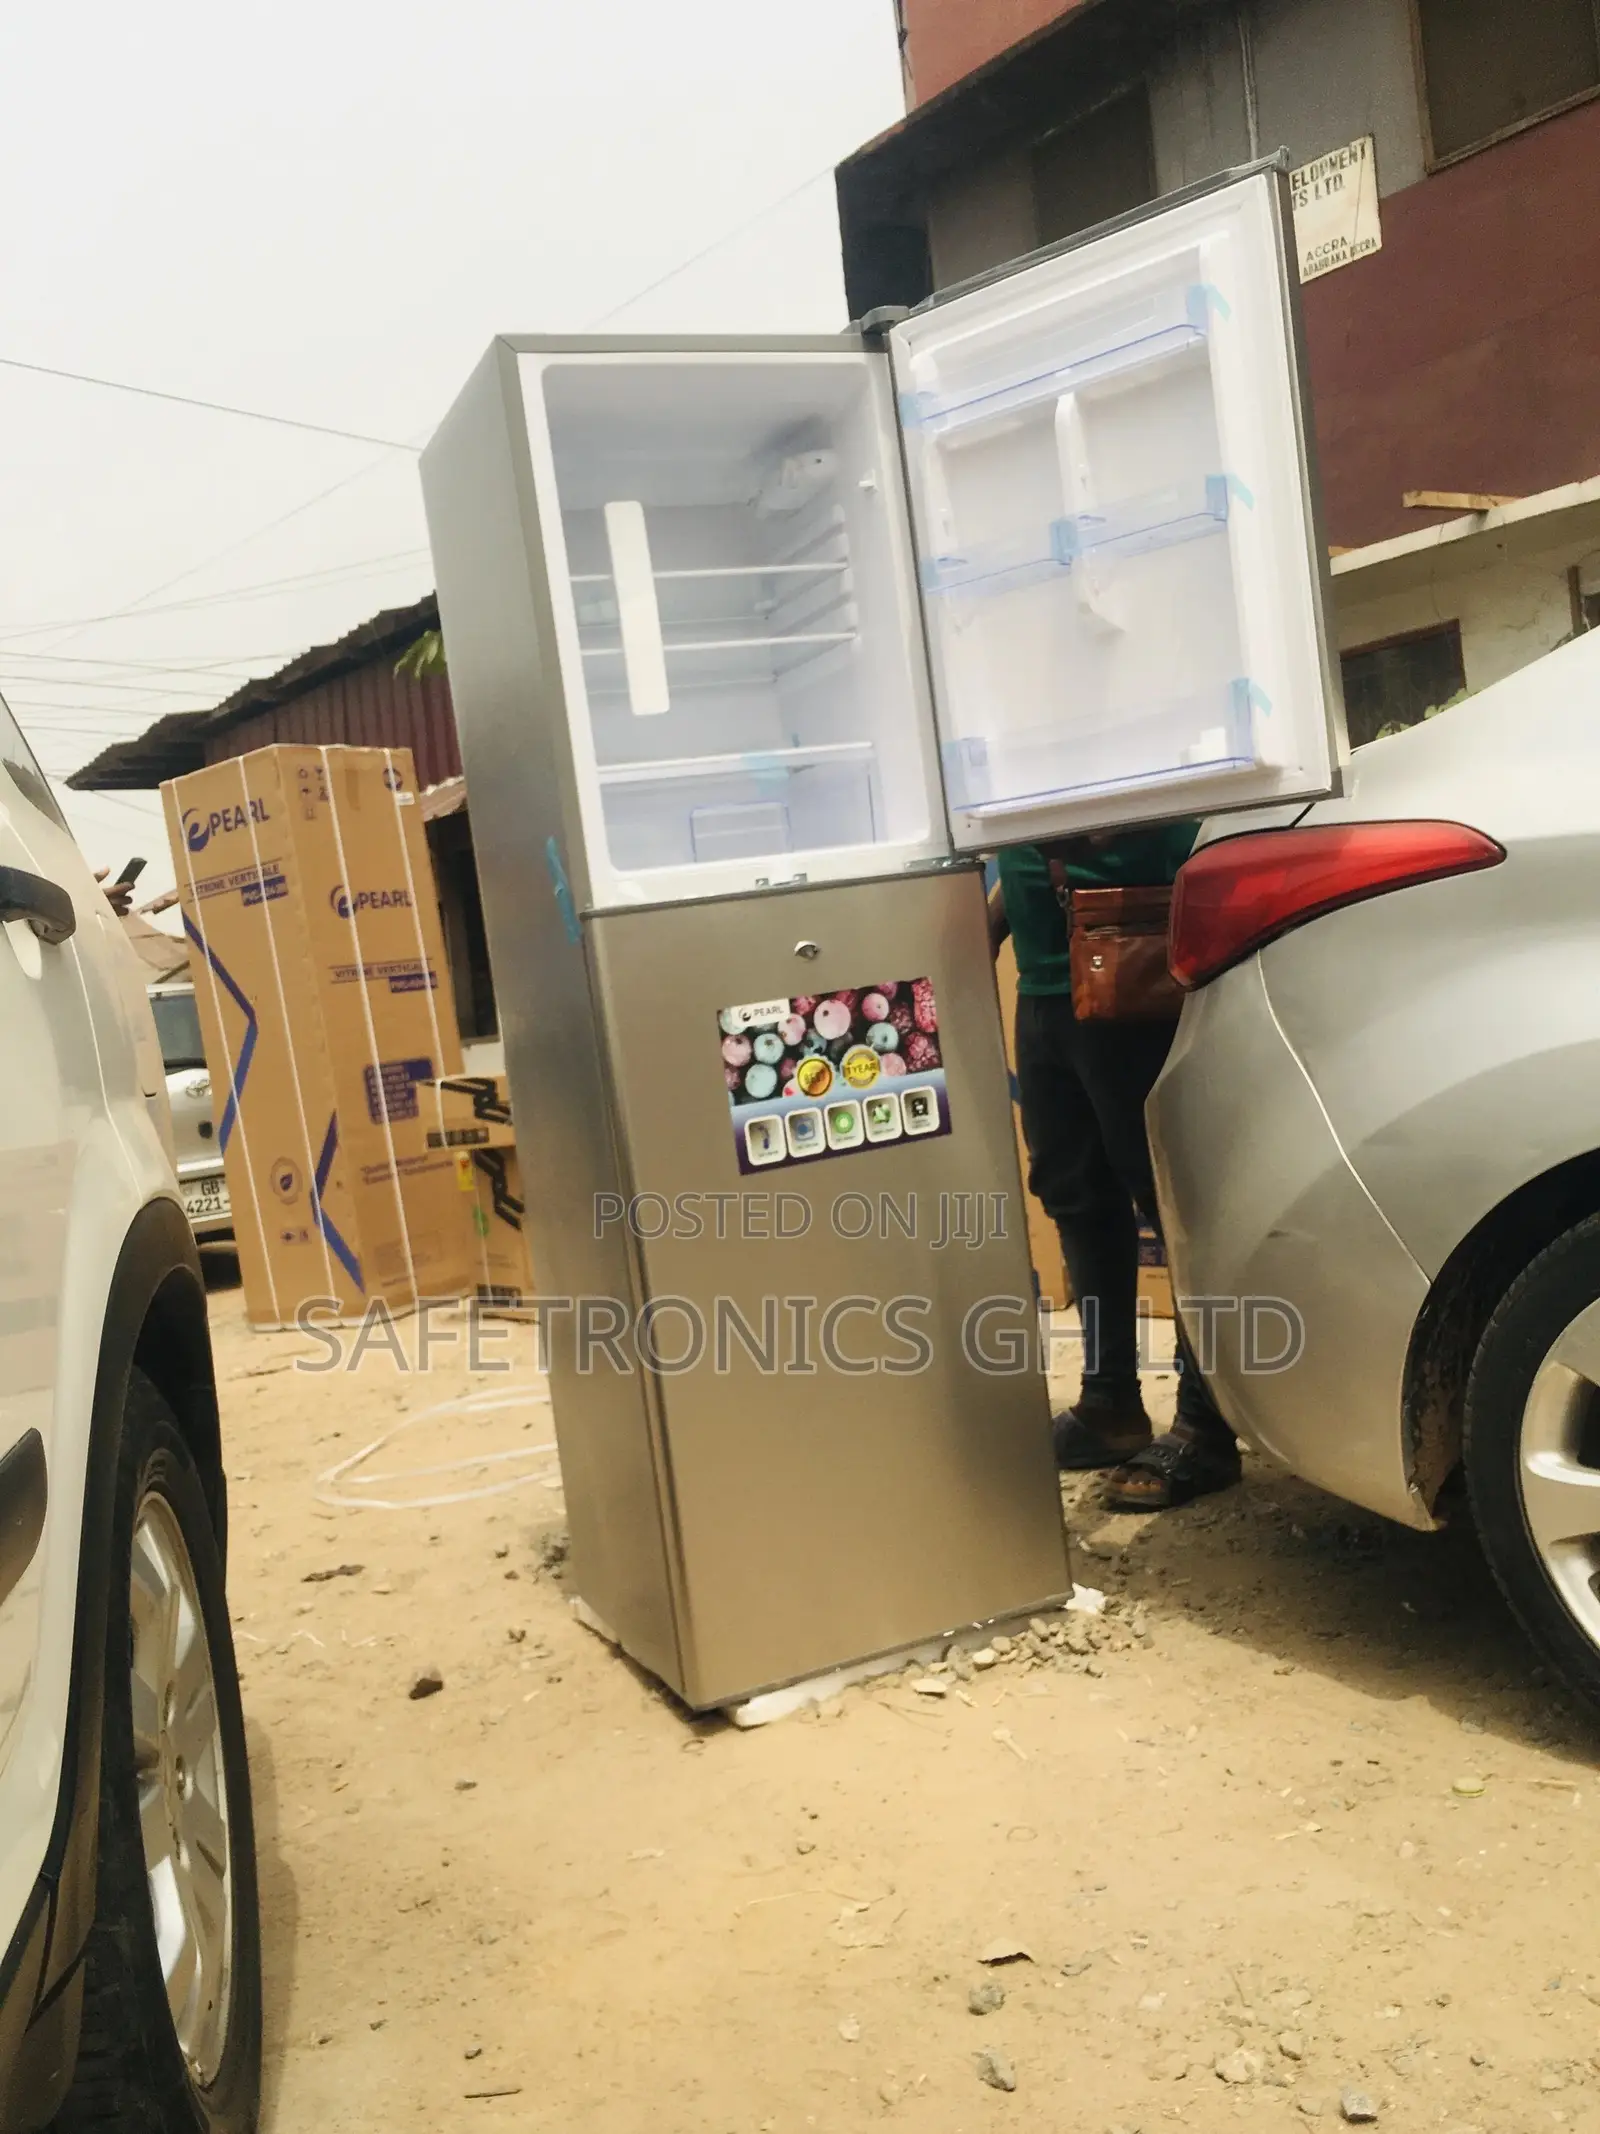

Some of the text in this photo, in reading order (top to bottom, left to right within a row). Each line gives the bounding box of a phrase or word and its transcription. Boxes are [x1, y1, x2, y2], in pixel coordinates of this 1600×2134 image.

[1291, 141, 1367, 191] ELOPMENT
[1292, 188, 1308, 211] TS
[209, 798, 271, 836] PEARL
[358, 890, 413, 910] PEARL
[752, 1005, 785, 1018] PEARL
[201, 1179, 220, 1196] GB
[186, 1196, 231, 1213] 4221-
